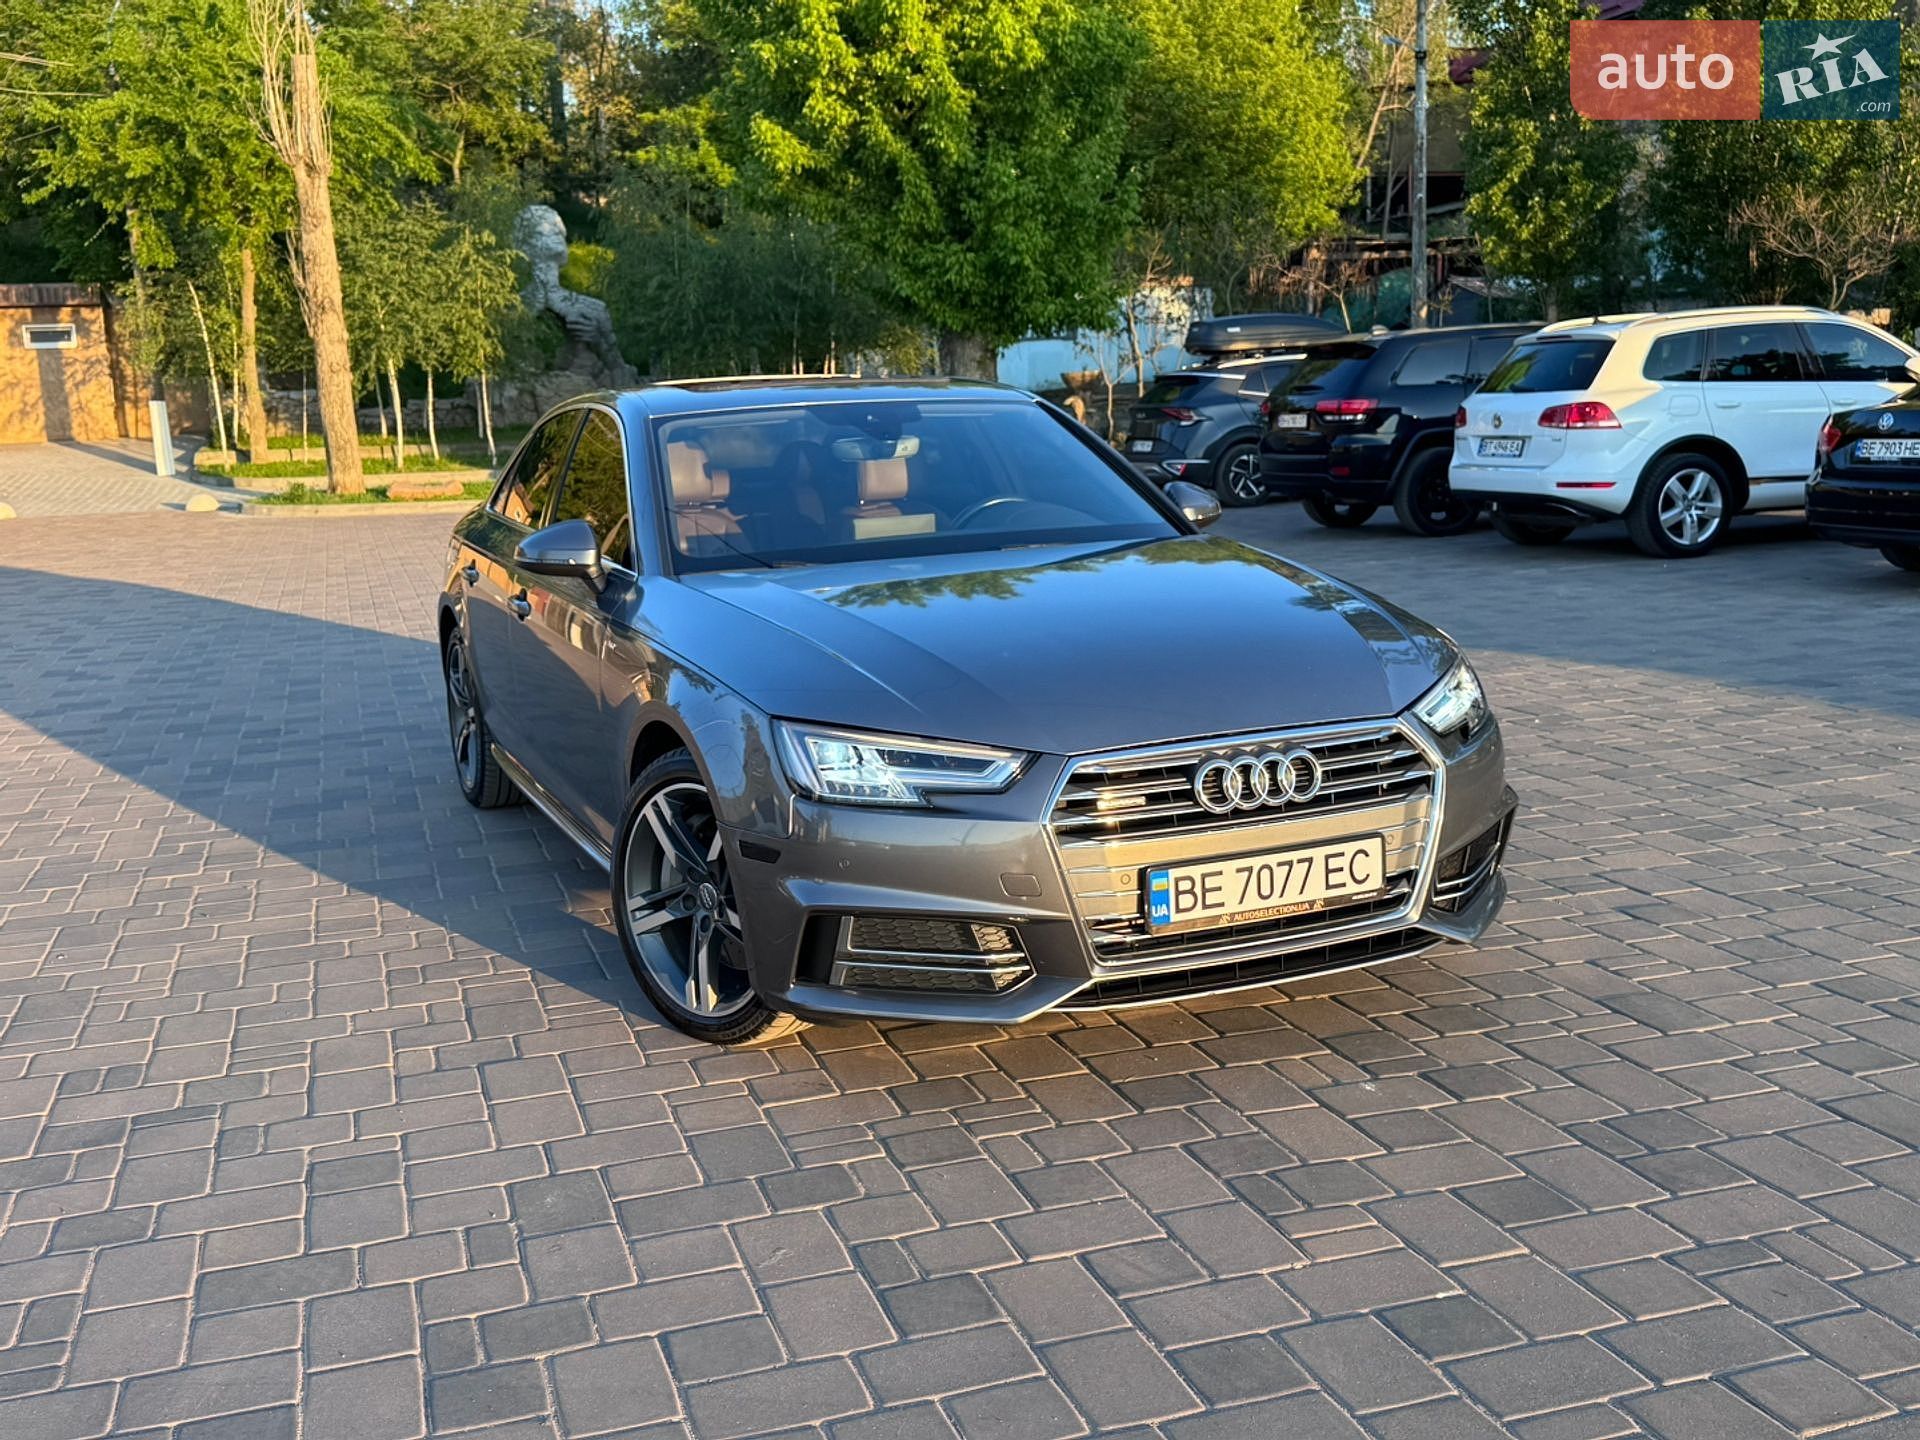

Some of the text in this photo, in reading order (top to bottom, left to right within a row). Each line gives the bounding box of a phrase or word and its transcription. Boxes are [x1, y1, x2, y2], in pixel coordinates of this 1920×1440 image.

[1861, 441, 1876, 455] BE
[1878, 441, 1902, 455] 7903
[1174, 848, 1370, 914] BE 7077 EC
[1152, 904, 1168, 917] UA
